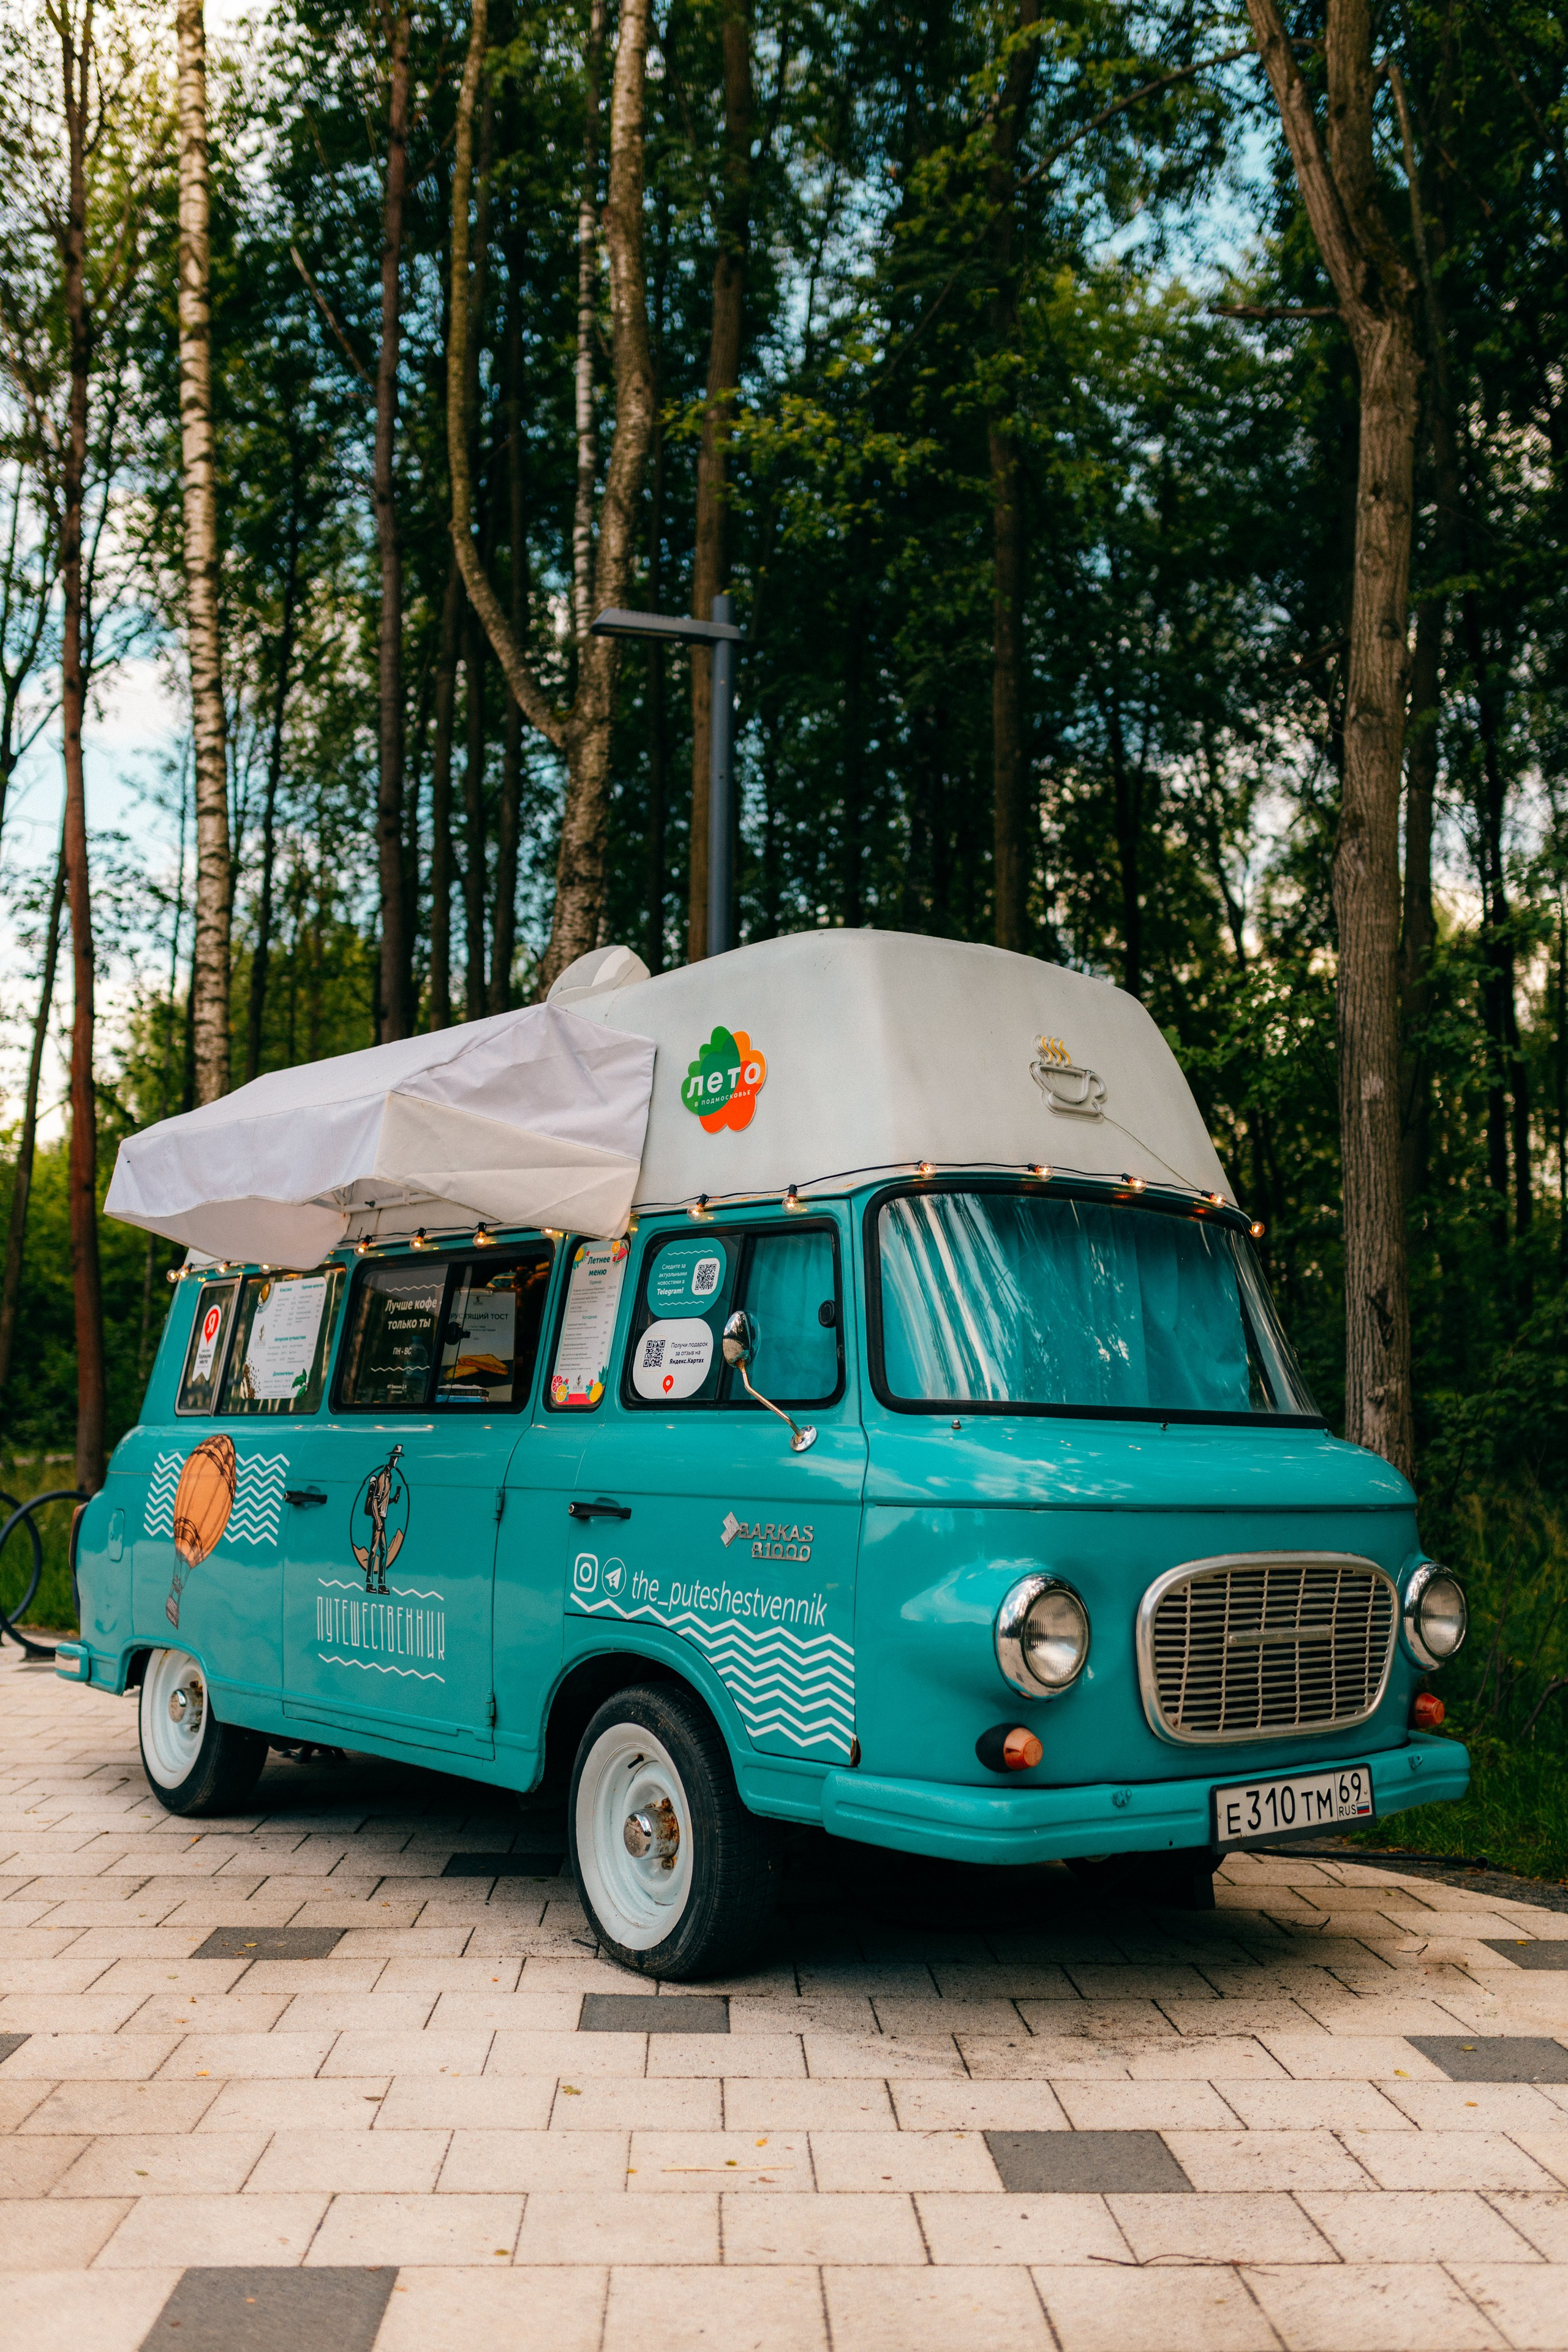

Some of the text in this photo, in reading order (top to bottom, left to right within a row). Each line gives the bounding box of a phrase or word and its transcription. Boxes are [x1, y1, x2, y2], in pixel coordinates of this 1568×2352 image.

[701, 1090, 751, 1106] ПОДМОСКОВЬЕ
[587, 1256, 611, 1265] Летнее
[588, 1268, 608, 1277] меню
[657, 1287, 684, 1296] Telegram!
[385, 1296, 437, 1315] Лучше кофе
[388, 1318, 431, 1330] только ты
[738, 1521, 813, 1542] BARKAS
[752, 1541, 811, 1562] B1000
[631, 1570, 827, 1627] the_puteshestvennik
[317, 1596, 445, 1661] ПУТЕШЕСТВЕННИК
[1339, 1772, 1362, 1803] 69
[1338, 1804, 1357, 1817] RUS
